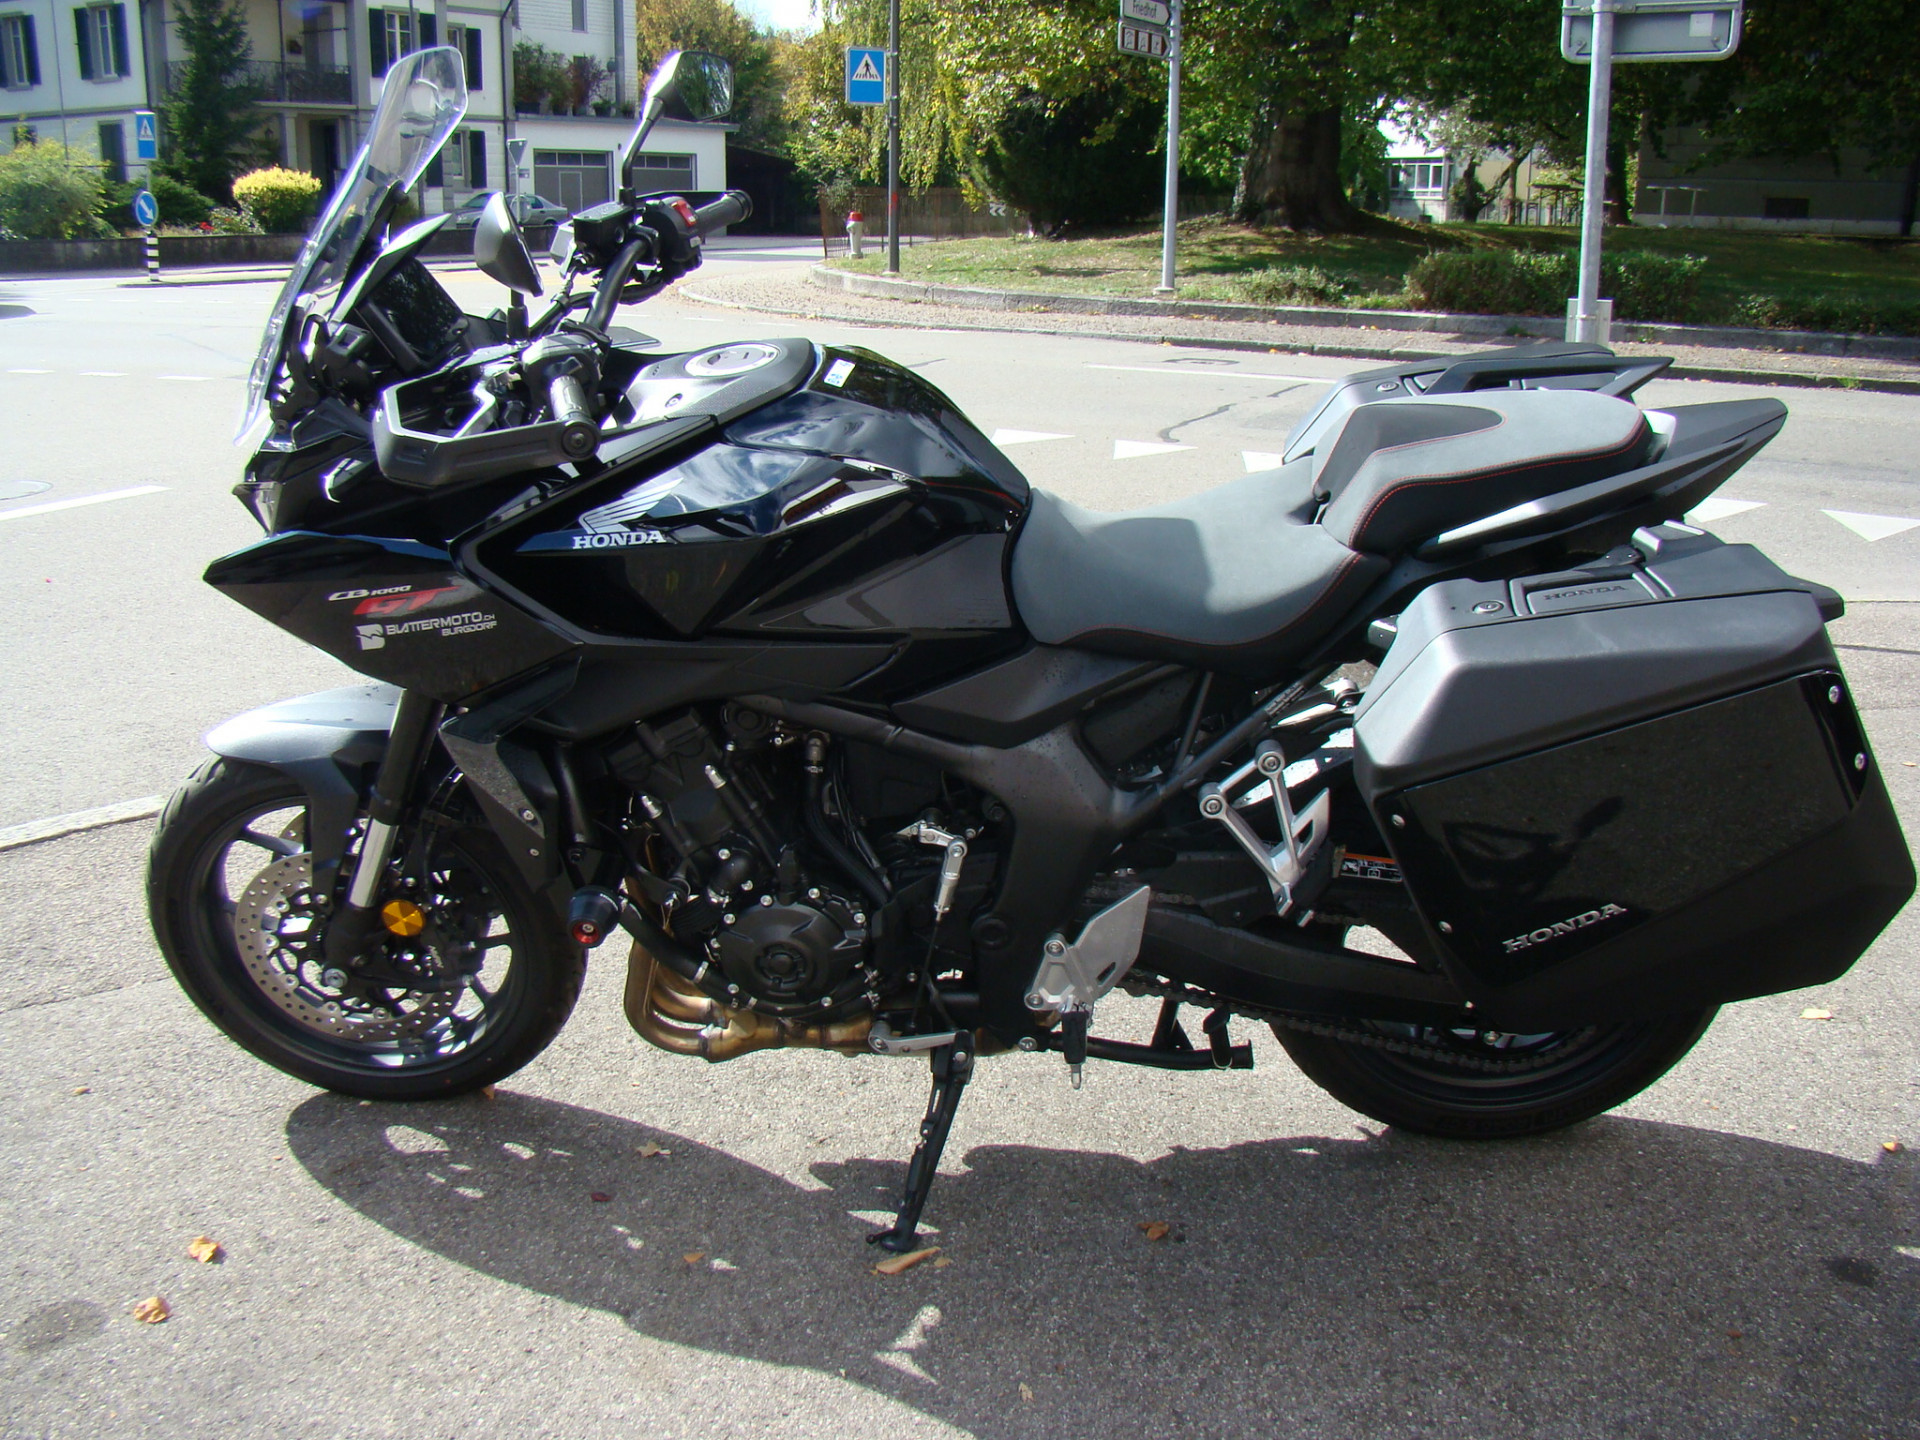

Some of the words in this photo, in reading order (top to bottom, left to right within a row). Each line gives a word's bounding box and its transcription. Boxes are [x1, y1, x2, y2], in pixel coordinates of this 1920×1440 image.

[572, 530, 667, 550] HONDA
[353, 585, 462, 615] GT
[1543, 585, 1627, 600] HONDA
[441, 620, 498, 637] BURGDORF
[1502, 903, 1628, 953] HONDA
